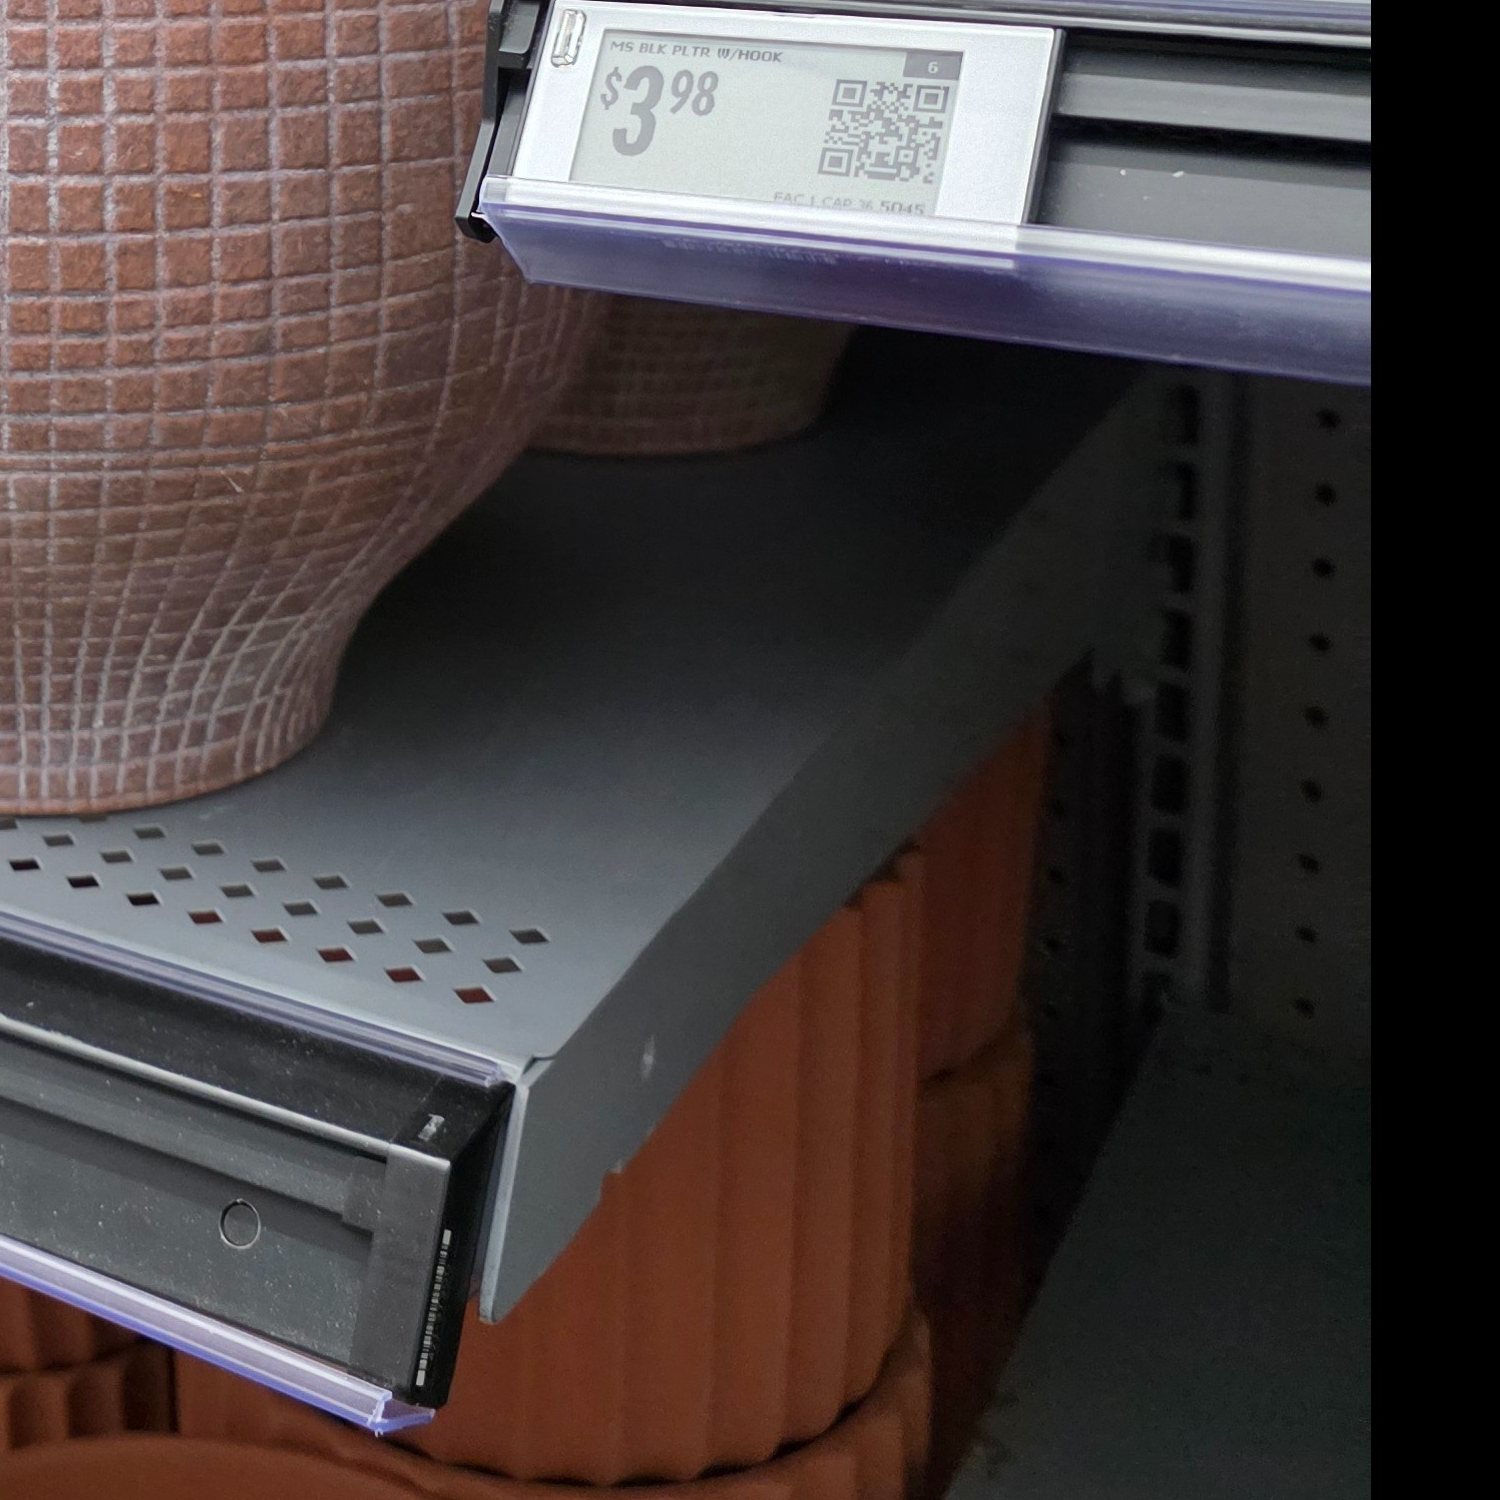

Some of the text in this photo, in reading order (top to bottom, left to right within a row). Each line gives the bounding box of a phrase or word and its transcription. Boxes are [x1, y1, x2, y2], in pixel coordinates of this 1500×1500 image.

[610, 40, 784, 63] MS BLK PLTR W/HOOK
[928, 61, 939, 74] 6
